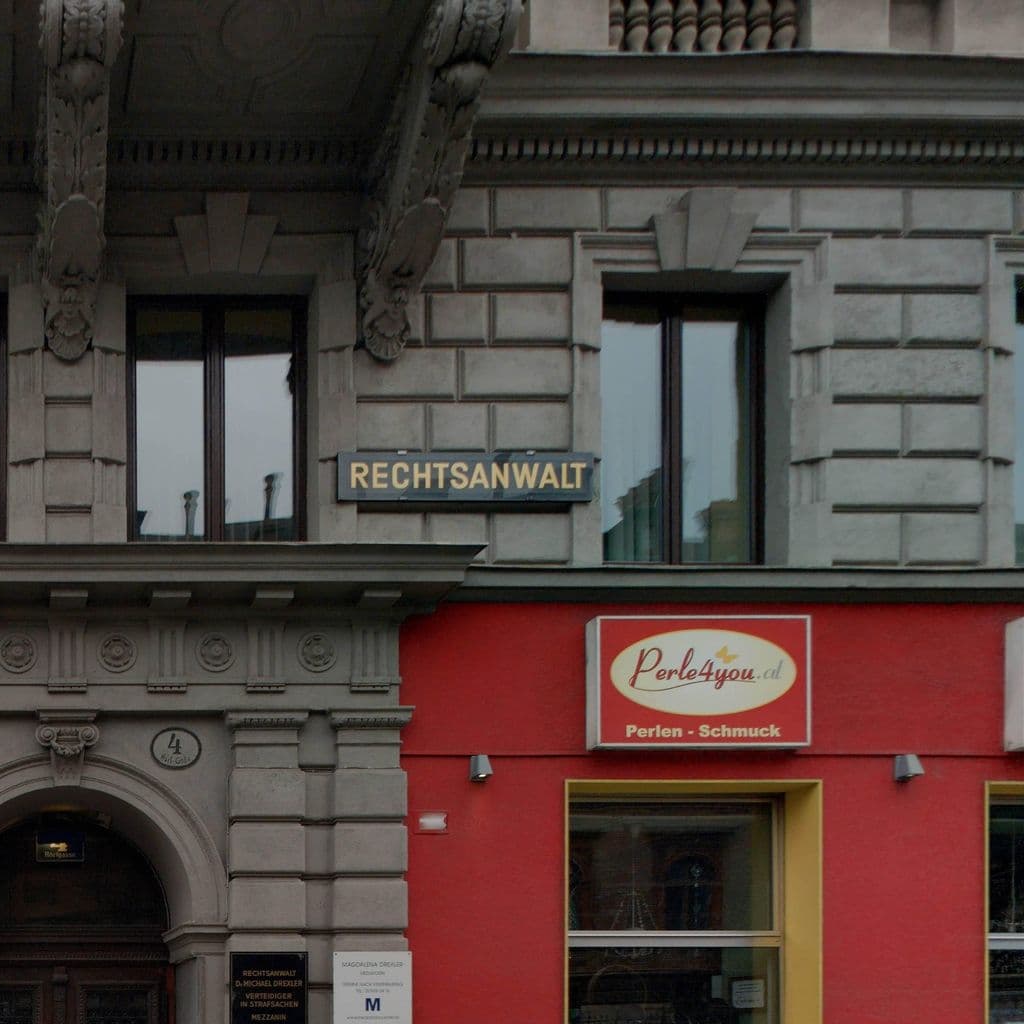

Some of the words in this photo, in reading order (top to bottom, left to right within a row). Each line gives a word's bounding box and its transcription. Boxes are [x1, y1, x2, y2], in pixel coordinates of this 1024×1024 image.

[349, 461, 587, 490] RECHTSANWALT
[625, 724, 683, 738] Perlen
[698, 724, 781, 738] Schmuck
[167, 733, 182, 755] 4
[242, 969, 297, 977] RECHTSANWALT
[273, 979, 303, 987] DREXLER
[245, 992, 293, 1000] VERTEIDIGER
[249, 1000, 299, 1008] STRAFSACHEN
[365, 997, 381, 1012] M
[251, 1013, 287, 1021] MEZZANIN
